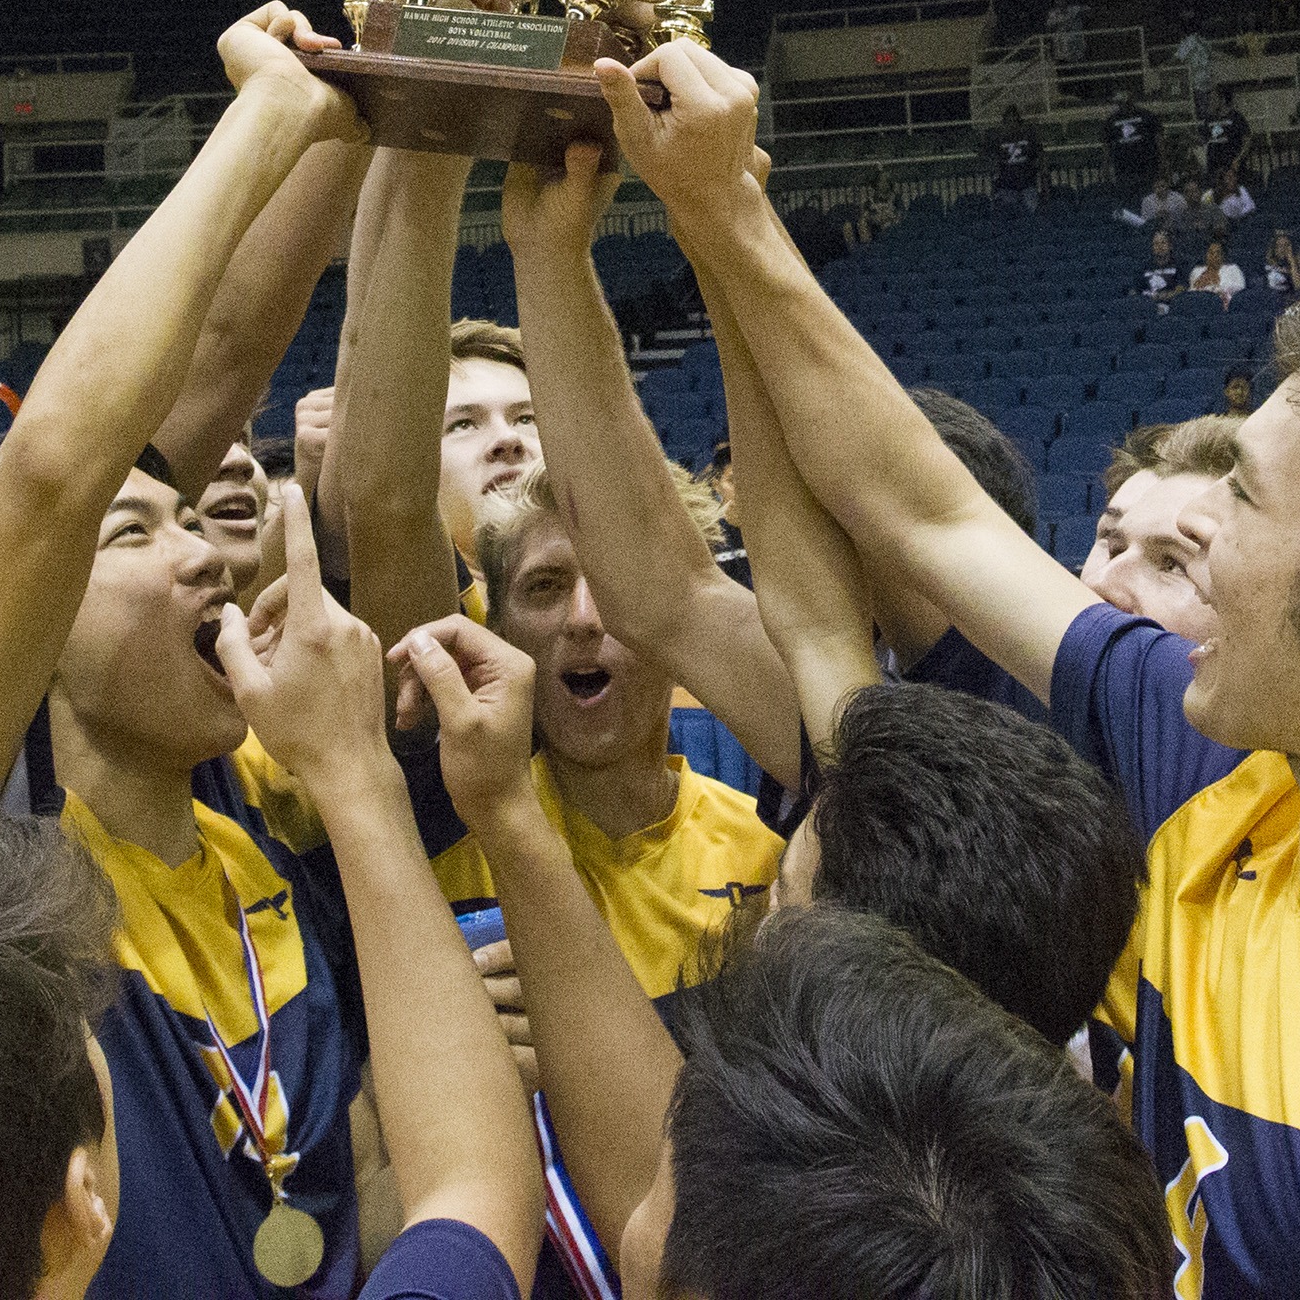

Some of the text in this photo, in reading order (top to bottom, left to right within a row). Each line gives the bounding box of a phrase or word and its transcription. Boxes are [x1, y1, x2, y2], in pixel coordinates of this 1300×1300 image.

[432, 14, 450, 23] HIGH
[451, 16, 478, 25] SCHOOL
[481, 18, 515, 29] ATHLETIC
[517, 22, 564, 33] ASSOCIATION
[448, 26, 512, 40] BOYS VOLLEYBALL
[426, 36, 447, 44] 2017
[447, 37, 480, 47] DIVISION
[486, 41, 529, 52] CHAMPIONS
